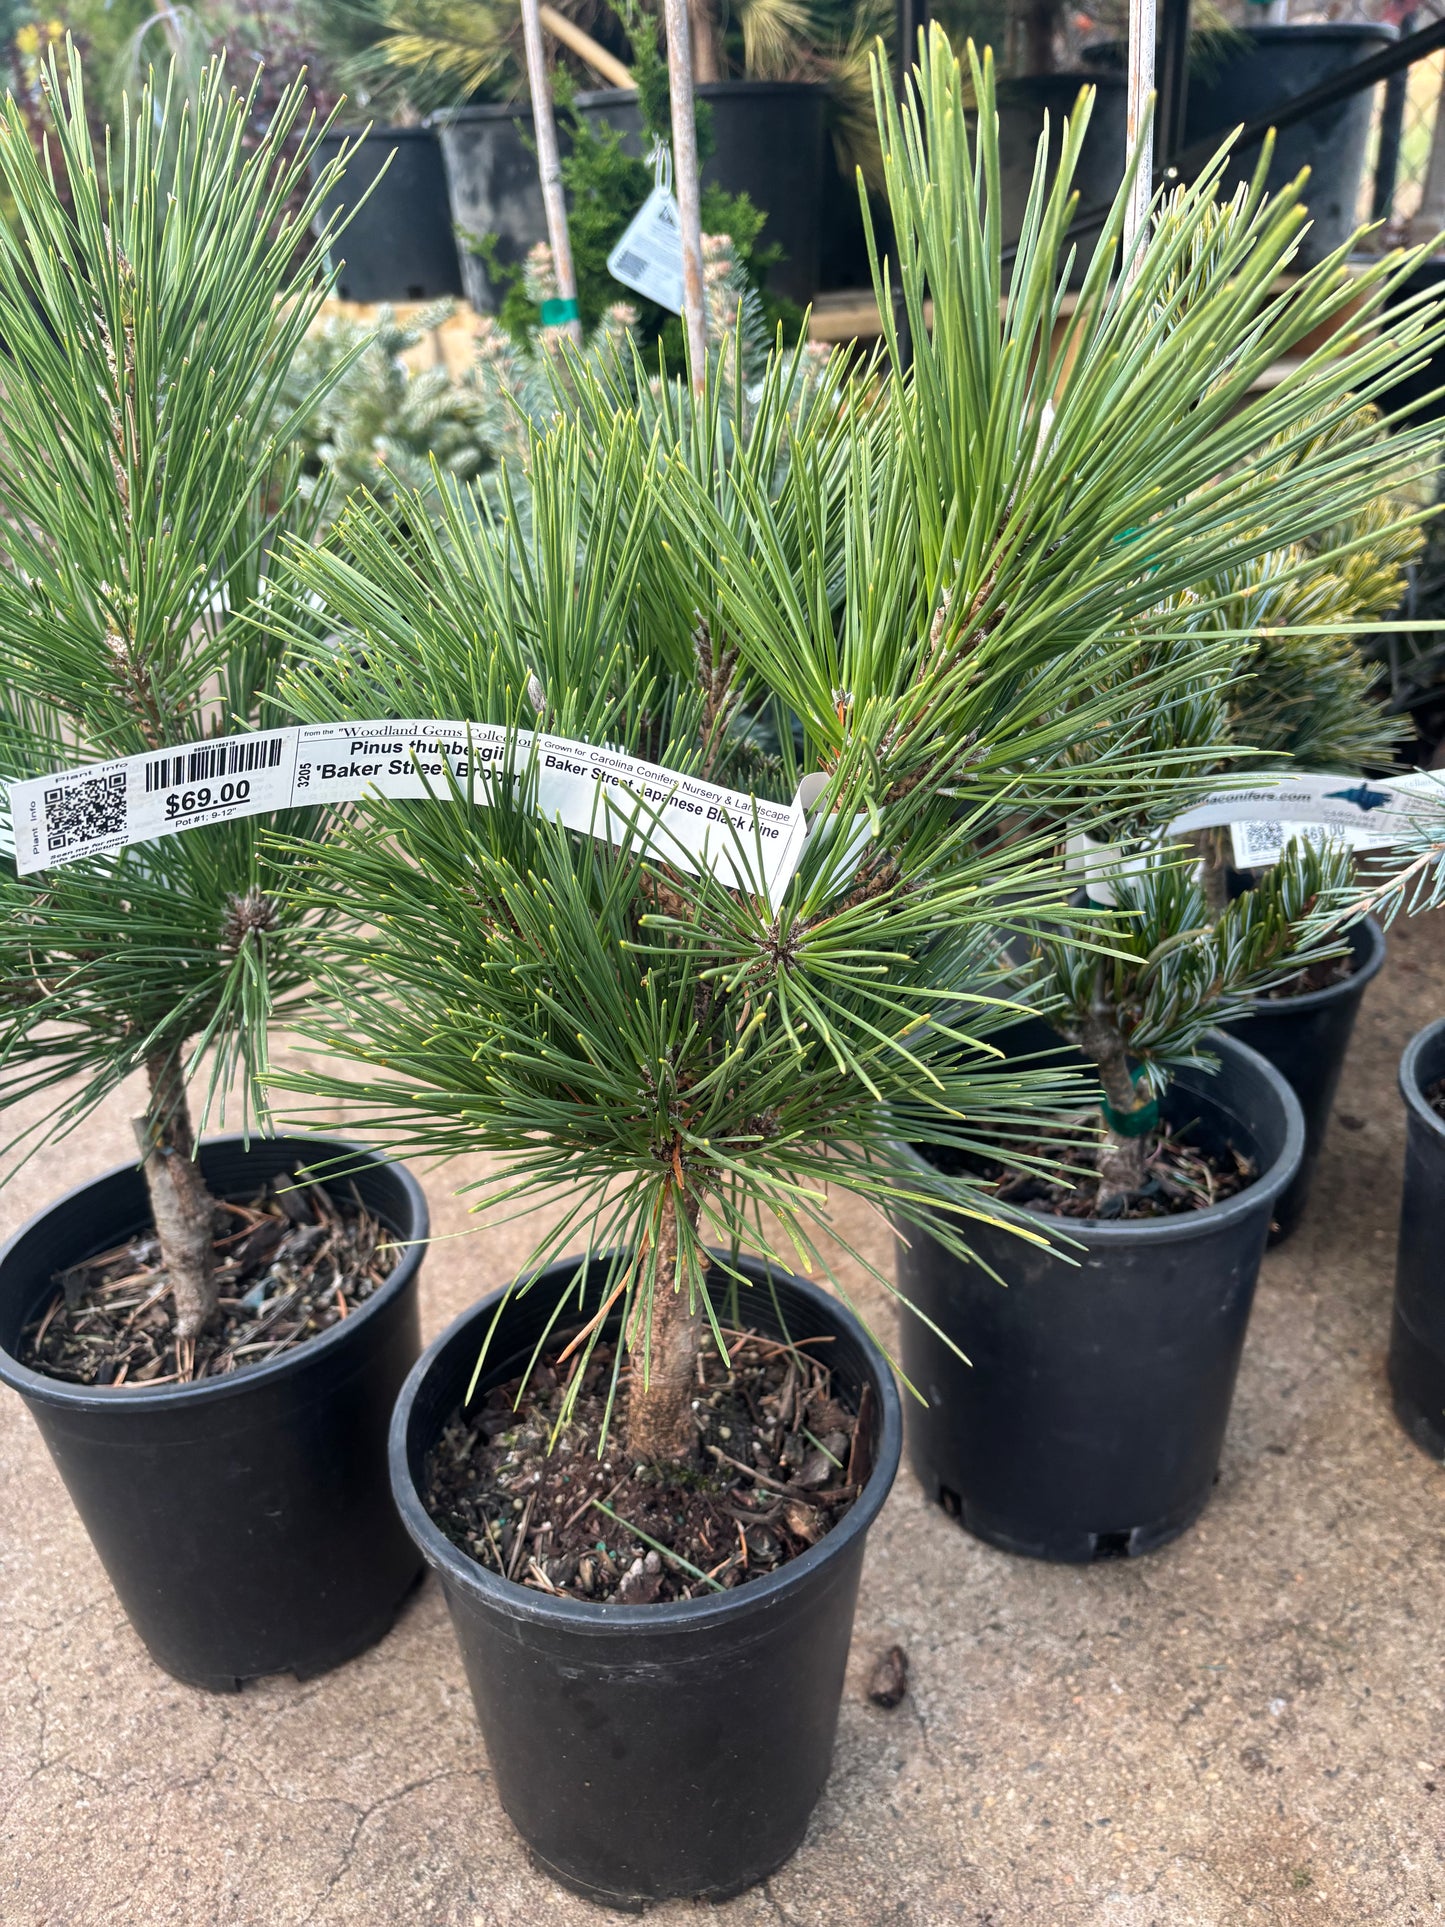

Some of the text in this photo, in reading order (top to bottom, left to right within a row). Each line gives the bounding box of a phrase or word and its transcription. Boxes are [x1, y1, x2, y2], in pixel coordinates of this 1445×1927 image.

[338, 725, 418, 737] "Woodland
[422, 725, 463, 737] Gems
[350, 740, 403, 755] Pinus
[55, 763, 128, 783] Plant Info
[297, 762, 312, 788] 3205
[316, 762, 383, 779] 'Baker
[388, 760, 447, 775] Stree
[545, 741, 572, 753] Grown
[574, 749, 587, 757] for
[590, 752, 634, 772] Carolina
[636, 766, 679, 786] Conifers
[682, 781, 722, 803] Nursery
[725, 796, 732, 805] &
[165, 780, 251, 818] $69.00
[545, 755, 588, 776] Baker
[706, 806, 746, 830] Black
[30, 801, 40, 855] Plant Info
[175, 818, 192, 828] Pot
[211, 807, 237, 819] 9-12"
[106, 835, 129, 844] more
